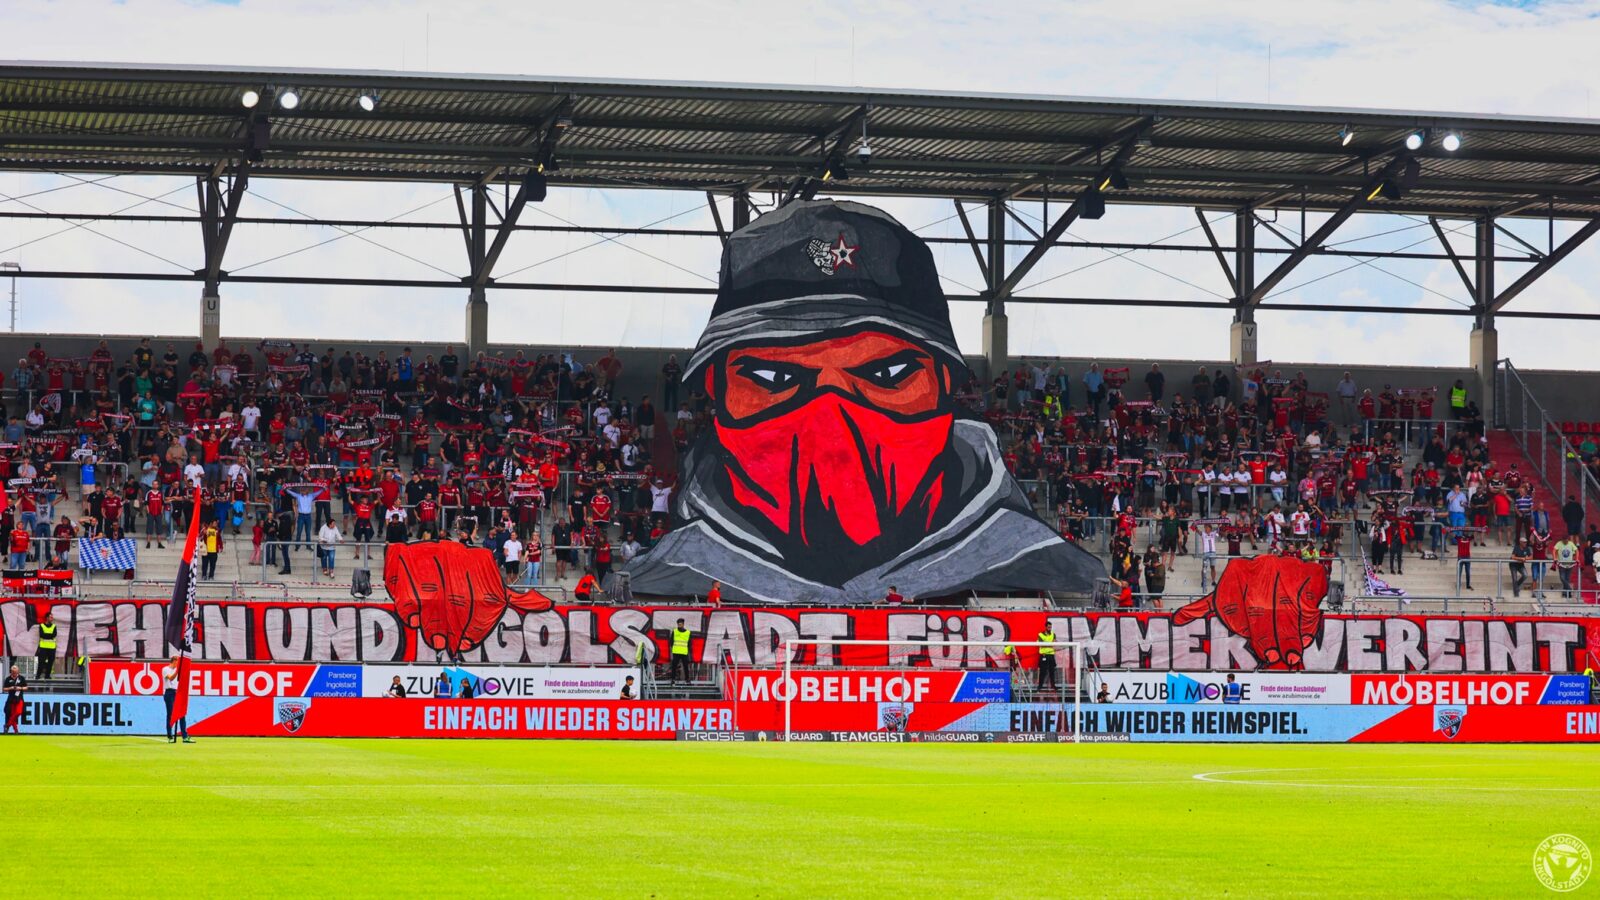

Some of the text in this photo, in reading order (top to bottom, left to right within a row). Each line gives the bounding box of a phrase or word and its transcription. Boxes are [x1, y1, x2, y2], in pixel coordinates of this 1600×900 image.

[207, 300, 217, 311] U
[1245, 327, 1254, 337] V
[265, 607, 400, 661] UND
[1303, 618, 1578, 672] VEREINT
[102, 665, 292, 695] MÖELHOF
[328, 672, 357, 680] Parsberg
[976, 677, 1004, 685] Parsberg
[326, 681, 357, 689] Ingolstadt
[580, 680, 616, 688] Ausbildung!
[1560, 681, 1584, 689] Parsberg
[974, 687, 1004, 695] Ingolstadt
[1115, 683, 1175, 700] AZUBI
[21, 702, 132, 726] EIMSPIEL.
[424, 706, 518, 730] EINFACH
[525, 707, 610, 731] WIEDER
[1010, 710, 1308, 734] EINFACH WIEDER HEIMSPIEL.
[1566, 712, 1600, 734] EIN
[831, 731, 905, 742] TEAMGEIST
[924, 732, 979, 741] hildeGUARD
[1007, 733, 1046, 743] guSTAFF
[1058, 733, 1129, 743] prodkte.prosis.de
